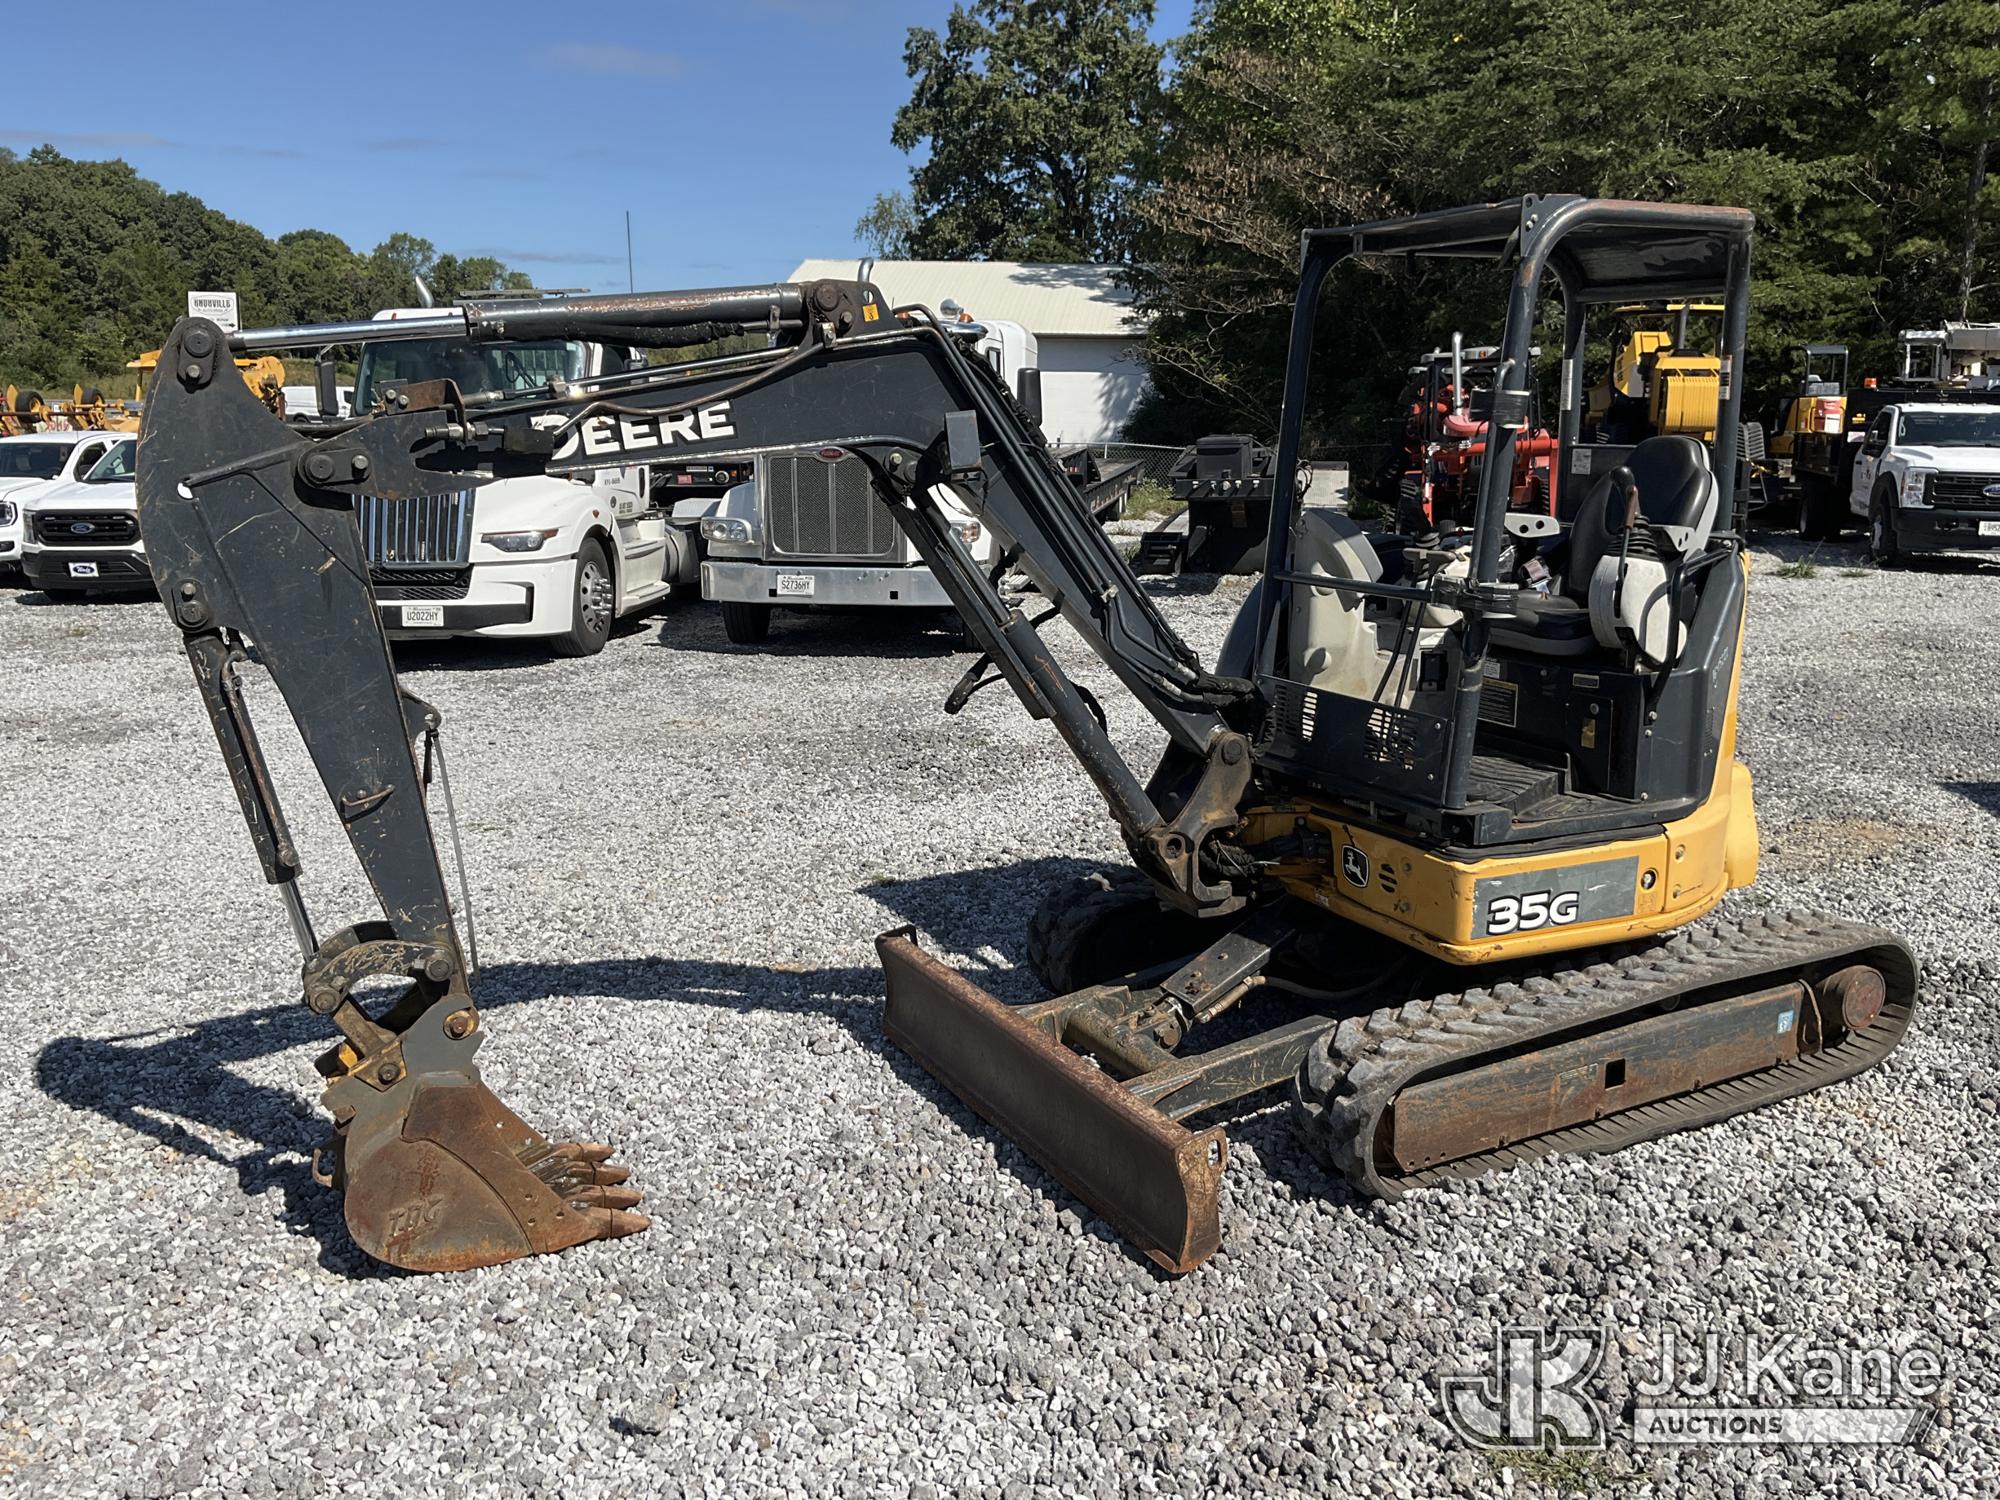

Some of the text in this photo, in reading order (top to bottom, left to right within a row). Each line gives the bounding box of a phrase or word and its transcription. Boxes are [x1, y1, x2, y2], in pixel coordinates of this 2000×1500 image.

[530, 400, 735, 461] DEERE
[406, 611, 438, 621] U2022HY
[1487, 890, 1580, 936] 35G
